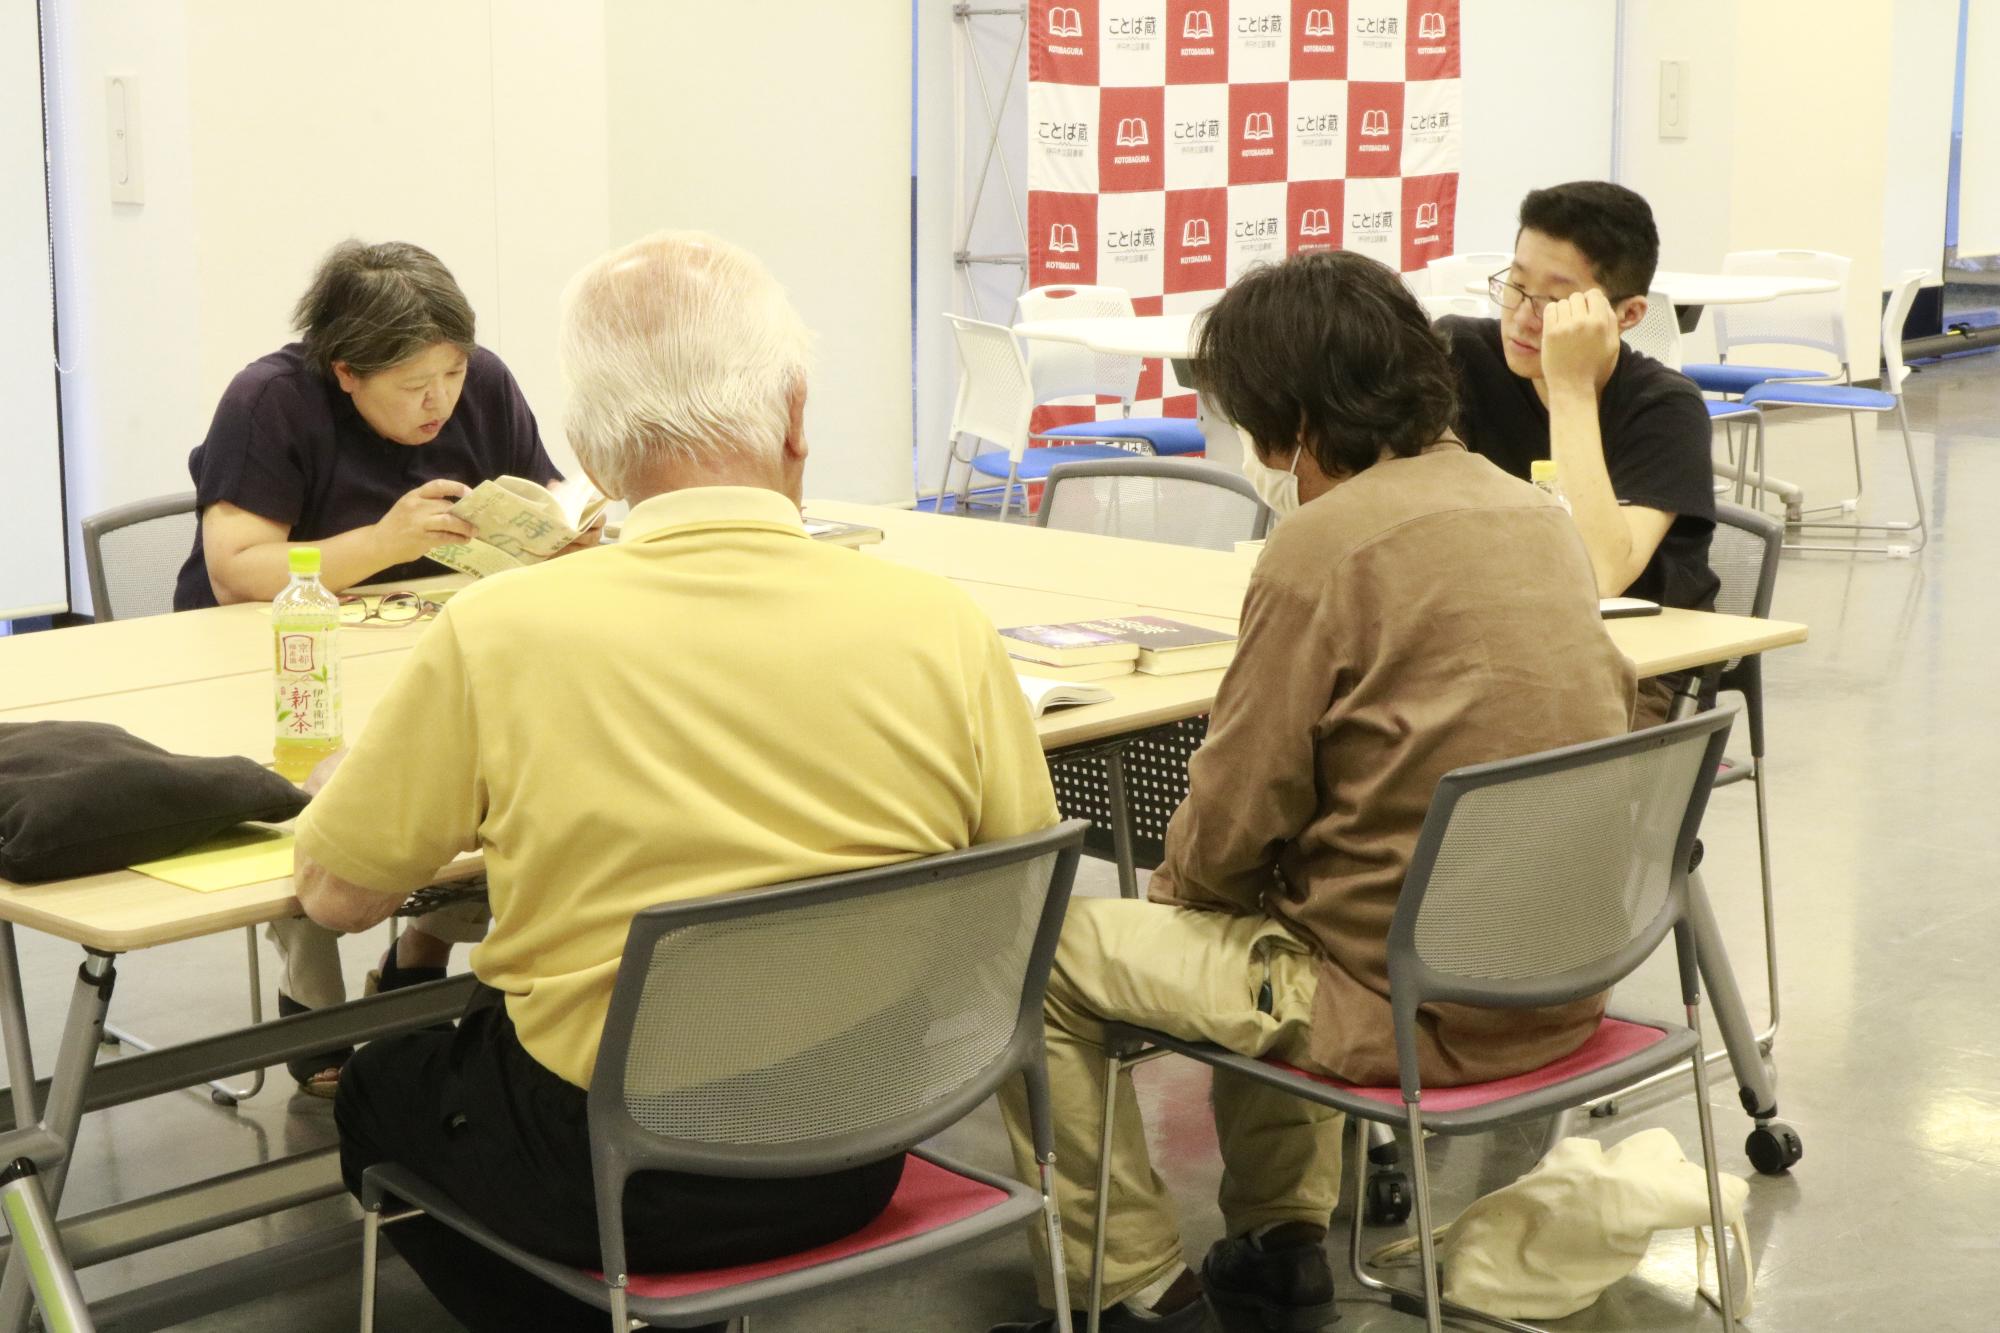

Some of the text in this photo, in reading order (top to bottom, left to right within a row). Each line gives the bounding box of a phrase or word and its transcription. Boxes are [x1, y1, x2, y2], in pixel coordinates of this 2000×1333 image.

[1108, 16, 1157, 35] ことば蔵
[1237, 15, 1283, 33] ことば蔵
[1356, 17, 1398, 35] ことば蔵
[1048, 45, 1084, 56] KOTOBAGURA
[1180, 48, 1215, 56] KOTOBAGURA
[1174, 120, 1220, 139] ことば蔵
[1296, 114, 1339, 132] ことば蔵
[1410, 112, 1450, 131] ことば蔵
[1038, 122, 1089, 141] ことば蔵
[1114, 154, 1150, 164] KOTOBAGURA
[1235, 217, 1278, 238] ことば蔵
[1351, 211, 1394, 229] ことば蔵
[1107, 228, 1155, 248] ことば蔵
[1180, 255, 1212, 264] KOTOBAGURA
[288, 687, 312, 734] 新茶
